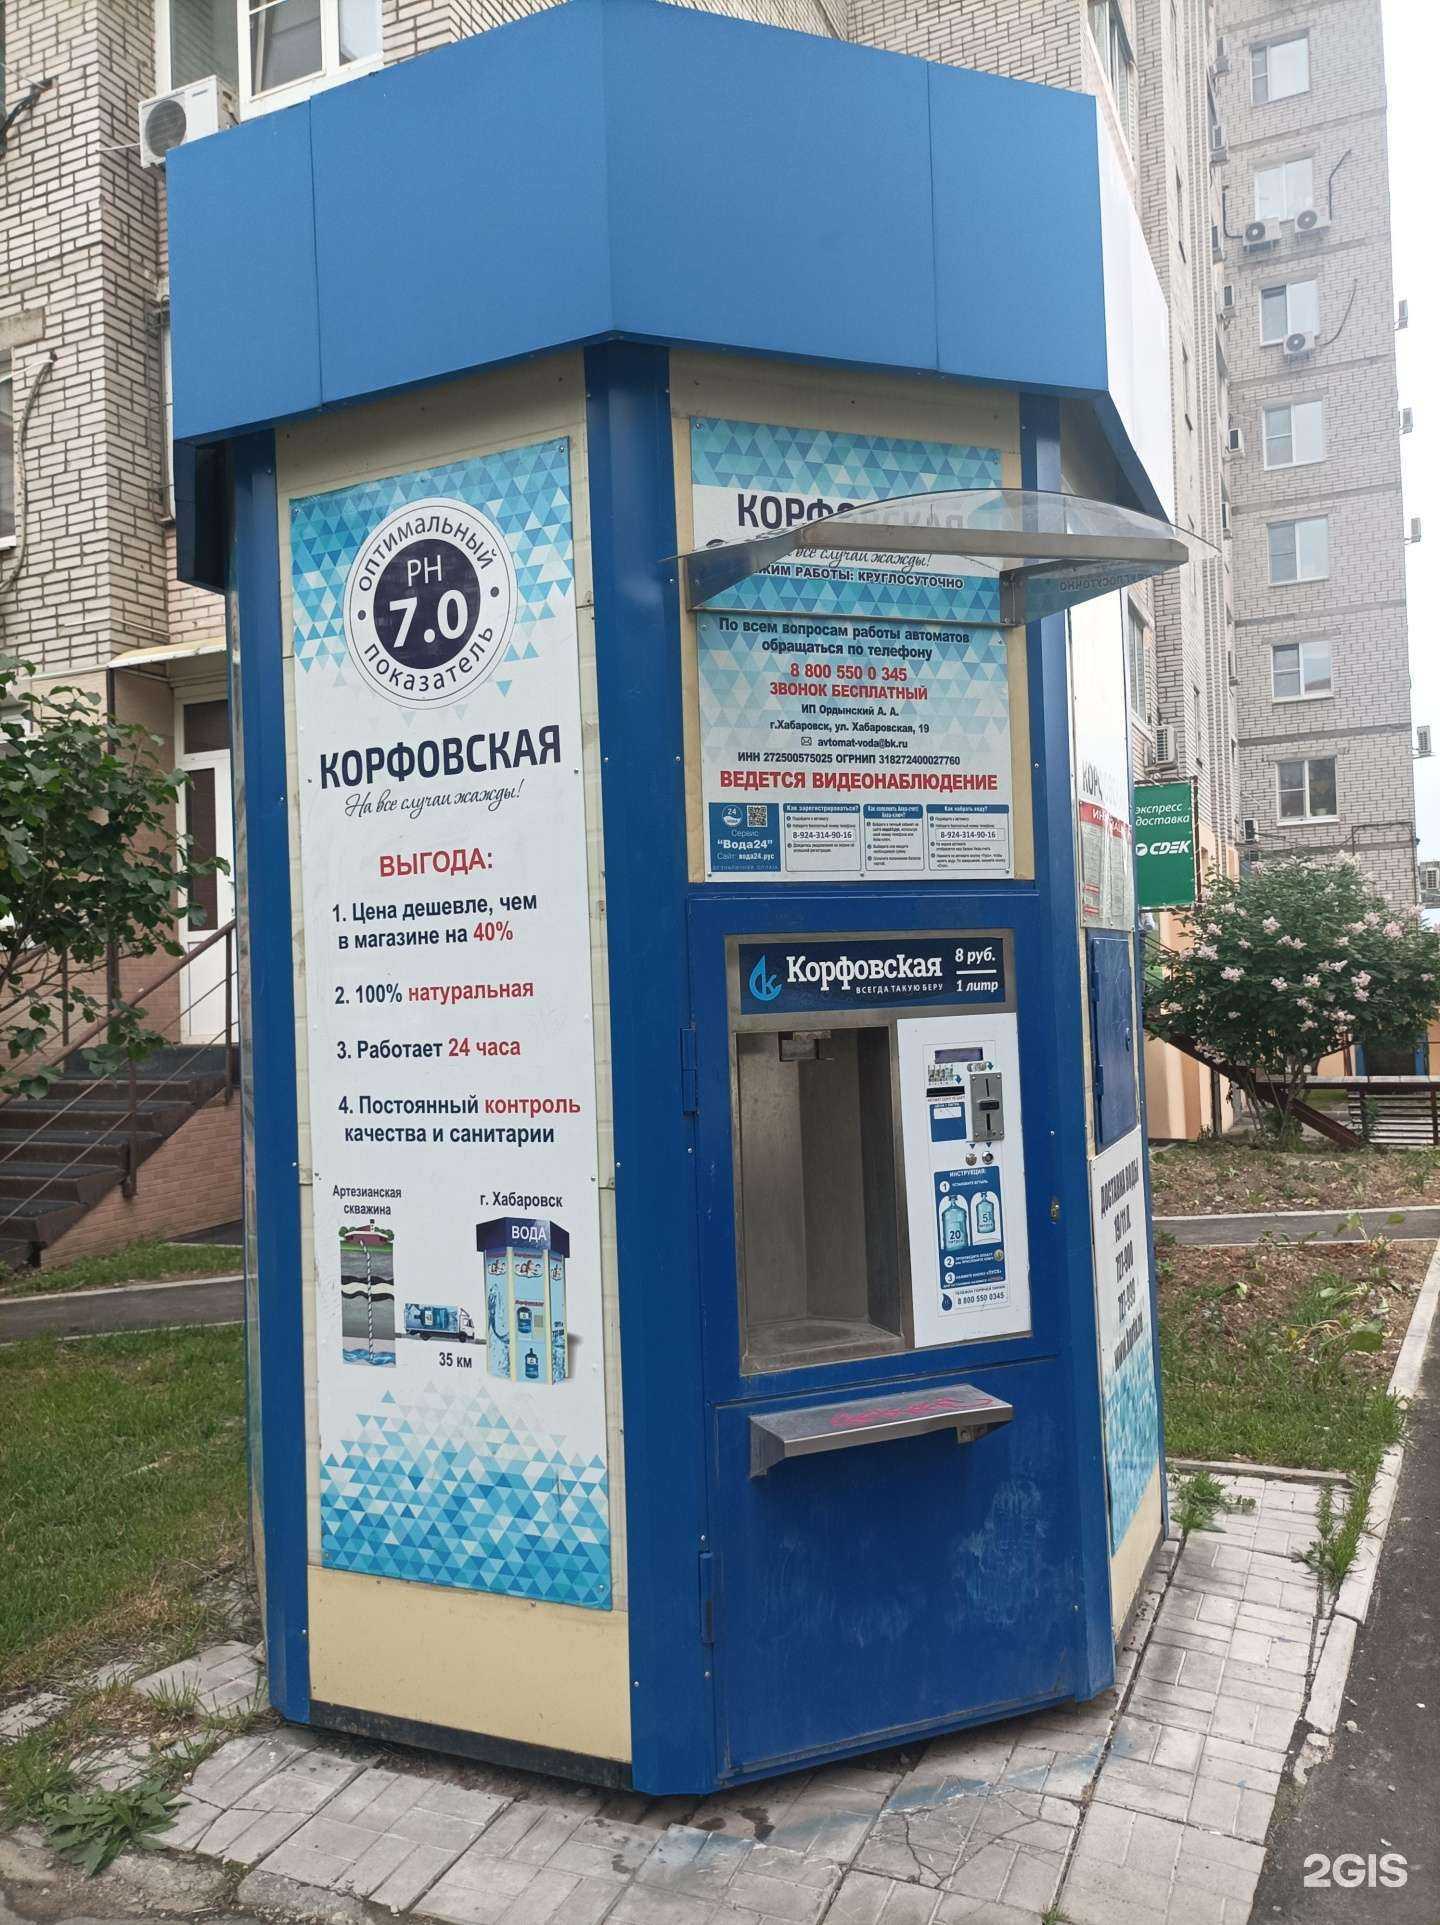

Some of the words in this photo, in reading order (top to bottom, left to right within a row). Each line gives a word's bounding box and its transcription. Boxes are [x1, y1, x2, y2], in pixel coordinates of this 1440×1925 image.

[359, 514, 498, 592] оптимальный
[820, 549, 868, 568] случаи
[870, 553, 932, 574] жажды!
[796, 566, 854, 580] РАБОТЫ:
[858, 571, 964, 589] КРУГЛОСУТОЧНО
[388, 589, 468, 648] 7.0
[719, 617, 738, 632] По
[742, 620, 778, 634] всем
[782, 622, 848, 639] вопросам
[852, 625, 900, 642] работы
[905, 629, 970, 643] автоматов
[364, 625, 493, 692] показатель
[761, 639, 843, 657] обращаться
[848, 644, 863, 657] по
[867, 645, 932, 661] телефону
[790, 663, 800, 677] 8
[804, 664, 831, 679] 800
[836, 665, 863, 680] 550
[867, 666, 876, 680] 0
[882, 667, 907, 682] 345
[769, 682, 827, 697] ЗВОНОК
[832, 684, 928, 701] БЕСПЛАТНЫЙ
[801, 704, 817, 714] ИП
[820, 705, 874, 718] Ордынский
[877, 707, 887, 716] А.
[890, 707, 899, 716] А.
[835, 723, 849, 733] ул.
[852, 722, 916, 735] Хабаровская,
[918, 723, 930, 734] 19
[817, 737, 908, 749] avtomat-voda@bk.ru
[320, 724, 562, 789] КОРФОВСКАЯ
[738, 752, 761, 762] ИНН
[763, 752, 833, 764] 272500575025
[836, 754, 875, 765] ОГРНИП
[879, 754, 961, 766] 318272400027760
[720, 770, 806, 791] ВЕДЕТСЯ
[812, 772, 998, 793] ВИДЕОНАБЛЮДЕНИЕ
[345, 792, 373, 819] На
[376, 790, 398, 815] все
[401, 793, 452, 819] случаи
[454, 778, 525, 812] жажды!
[1135, 803, 1182, 815] экспресс
[1136, 815, 1190, 826] доставка
[731, 830, 759, 838] Сервис
[792, 831, 852, 839] 8-924-314-90-16
[1150, 840, 1192, 855] CDEK
[379, 848, 493, 878] ВЫГОДА:
[332, 904, 347, 923] 1.
[352, 900, 397, 924] Цена
[402, 897, 493, 921] дешевле,
[499, 894, 537, 911] чем
[338, 934, 349, 949] в
[354, 928, 440, 948] магазине
[445, 927, 468, 943] на
[473, 921, 514, 942] 40%
[955, 948, 963, 962] 8
[966, 947, 996, 965] руб.
[786, 954, 943, 991] Корфовская
[334, 986, 350, 1005] 2.
[355, 983, 403, 1004] 100%
[408, 982, 534, 1005] натуральная
[856, 986, 889, 994] ВСЕГДА
[889, 984, 920, 993] ТАКУЮ
[921, 983, 943, 992] БЕРУ
[956, 980, 962, 992] 1
[966, 980, 998, 994] литр
[336, 1040, 351, 1059] 3.
[357, 1040, 443, 1059] Работает
[448, 1038, 470, 1057] 24
[476, 1040, 521, 1057] часа
[338, 1096, 354, 1114] 4.
[358, 1095, 479, 1115] Постоянный
[484, 1098, 581, 1119] контроль
[344, 1126, 427, 1143] качества
[432, 1127, 444, 1142] и
[449, 1126, 555, 1147] санитарии
[332, 1184, 402, 1200] Артезианская
[480, 1194, 490, 1206] г.
[492, 1192, 563, 1210] Хабаровск
[343, 1203, 391, 1216] скважина
[511, 1226, 547, 1243] ВОДА
[949, 1230, 961, 1240] 20
[438, 1352, 453, 1367] 35
[456, 1356, 472, 1368] км
